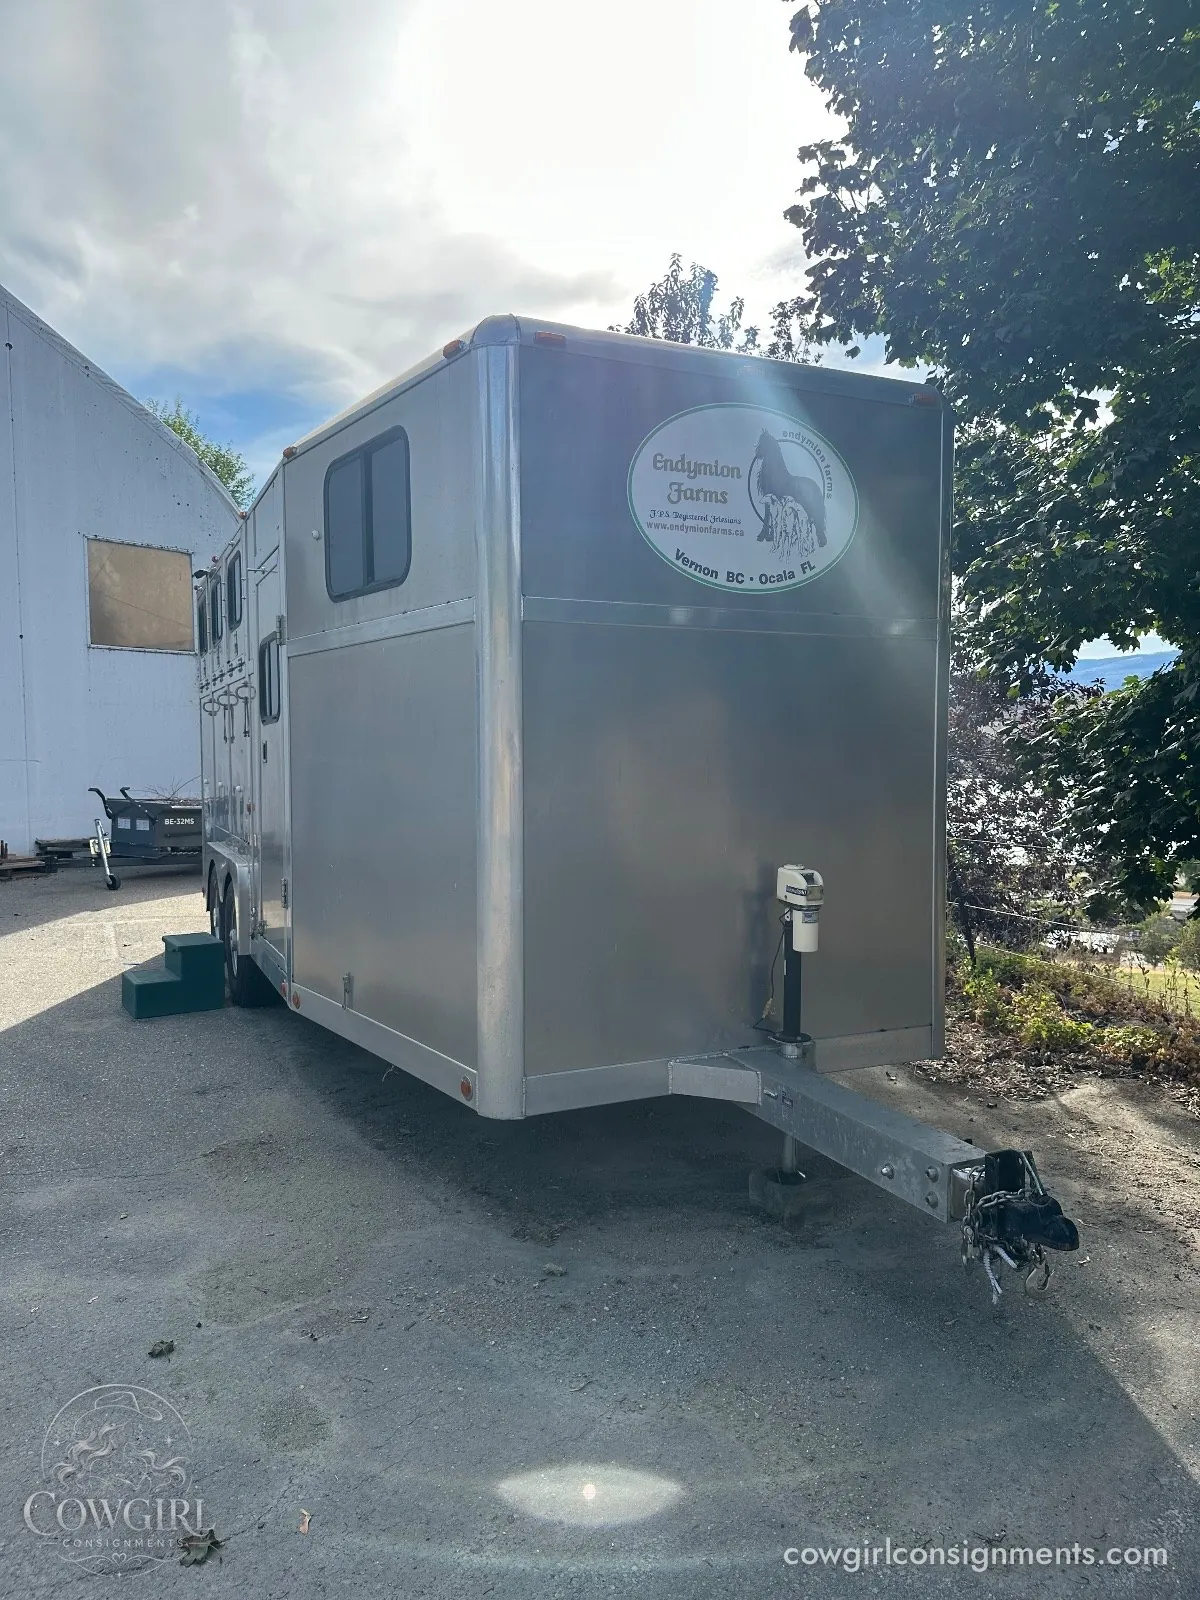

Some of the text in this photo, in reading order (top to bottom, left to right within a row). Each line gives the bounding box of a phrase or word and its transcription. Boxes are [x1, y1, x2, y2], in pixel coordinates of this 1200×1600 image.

[652, 452, 742, 479] Endymion
[782, 430, 833, 500] endymion farms
[667, 481, 729, 505] Farms
[646, 521, 745, 537] www.endymionfarms.ca
[672, 511, 709, 522] Registered
[675, 548, 816, 585] Vernon BC Ocala FL
